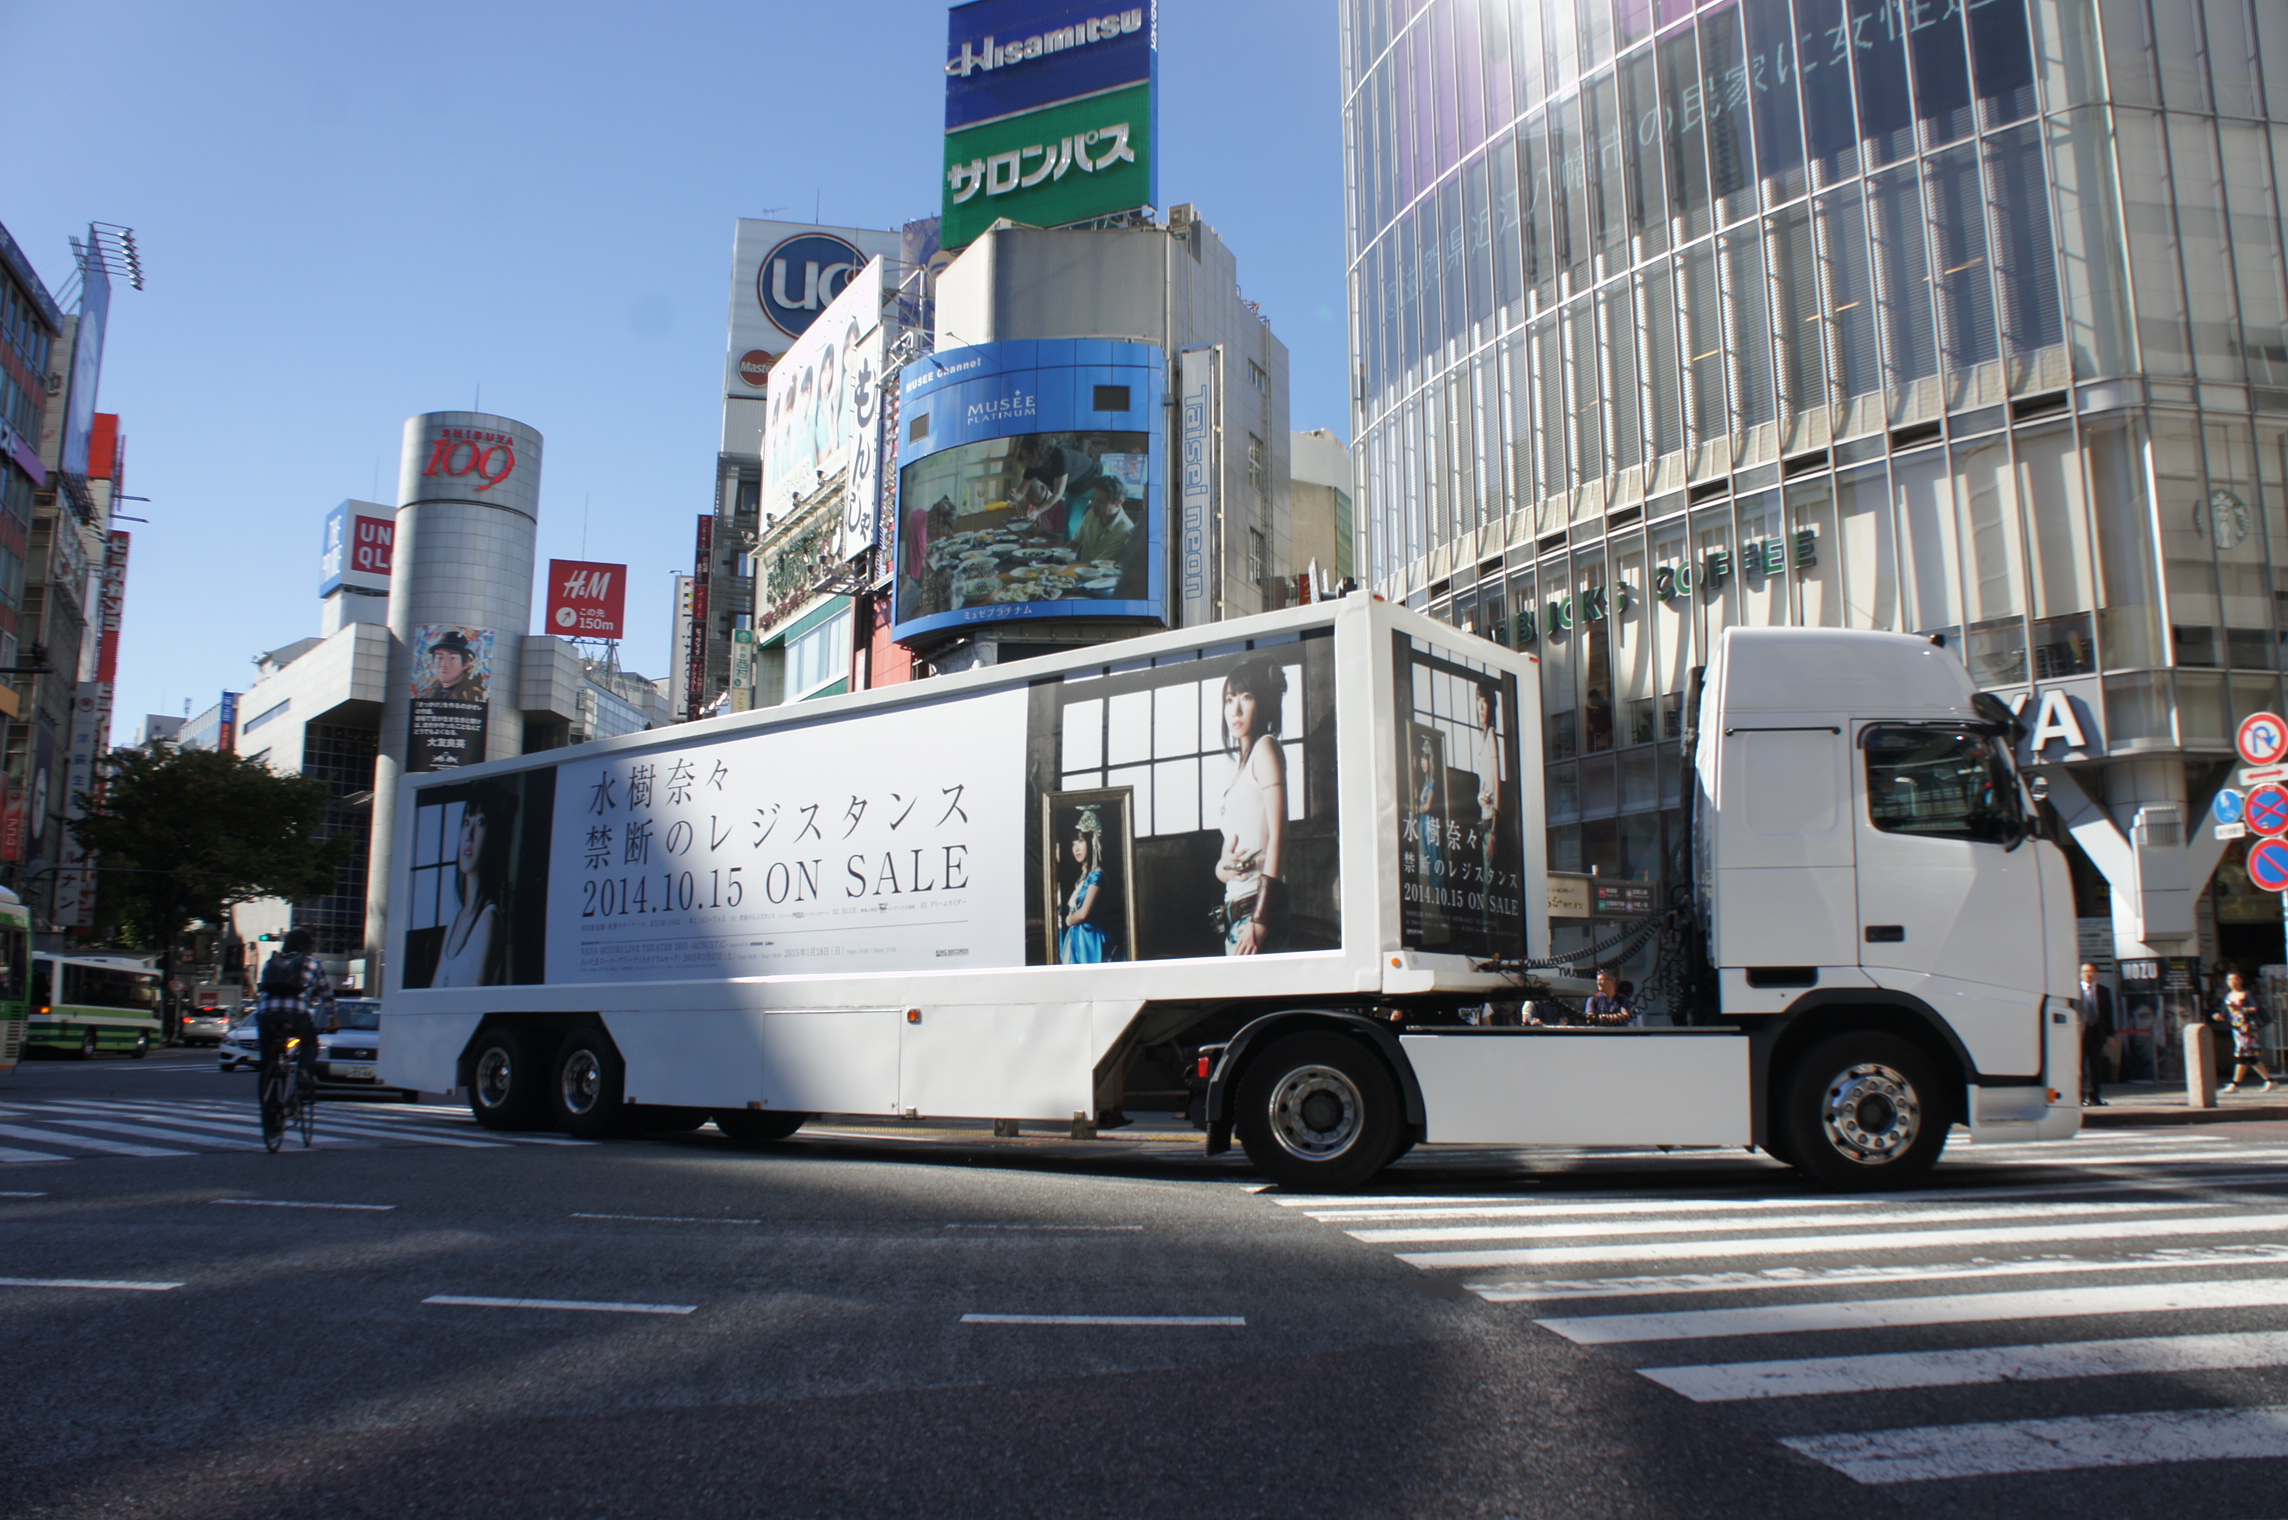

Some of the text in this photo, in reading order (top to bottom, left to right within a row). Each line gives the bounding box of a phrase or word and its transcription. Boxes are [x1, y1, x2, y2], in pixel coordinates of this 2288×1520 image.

[944, 8, 1141, 77] Hisamitsu
[948, 122, 1134, 205] サロンパス
[740, 361, 773, 374] Maste
[905, 357, 982, 393] MUSEE Channel
[967, 408, 1036, 426] PLATINUM
[441, 428, 514, 446] SHIBUYA
[421, 439, 515, 491] 109
[1185, 383, 1208, 600] Taisei neon
[358, 546, 393, 569] QL
[1656, 529, 1817, 602] COFFEE
[562, 570, 612, 601] H&M
[579, 608, 606, 618] この先
[579, 617, 614, 631] 150m
[964, 605, 1032, 620] ミュゼプラチナム
[587, 757, 730, 816] 水樹奈々
[584, 784, 969, 870] 禁断のレジスタンス
[1402, 812, 1477, 850] 水樹奈々
[582, 844, 969, 918] 2014.10.15 ON SALE
[1403, 851, 1517, 888] 禁断のレジスタンス
[1404, 883, 1519, 916] 2014.10.15 ON SALE
